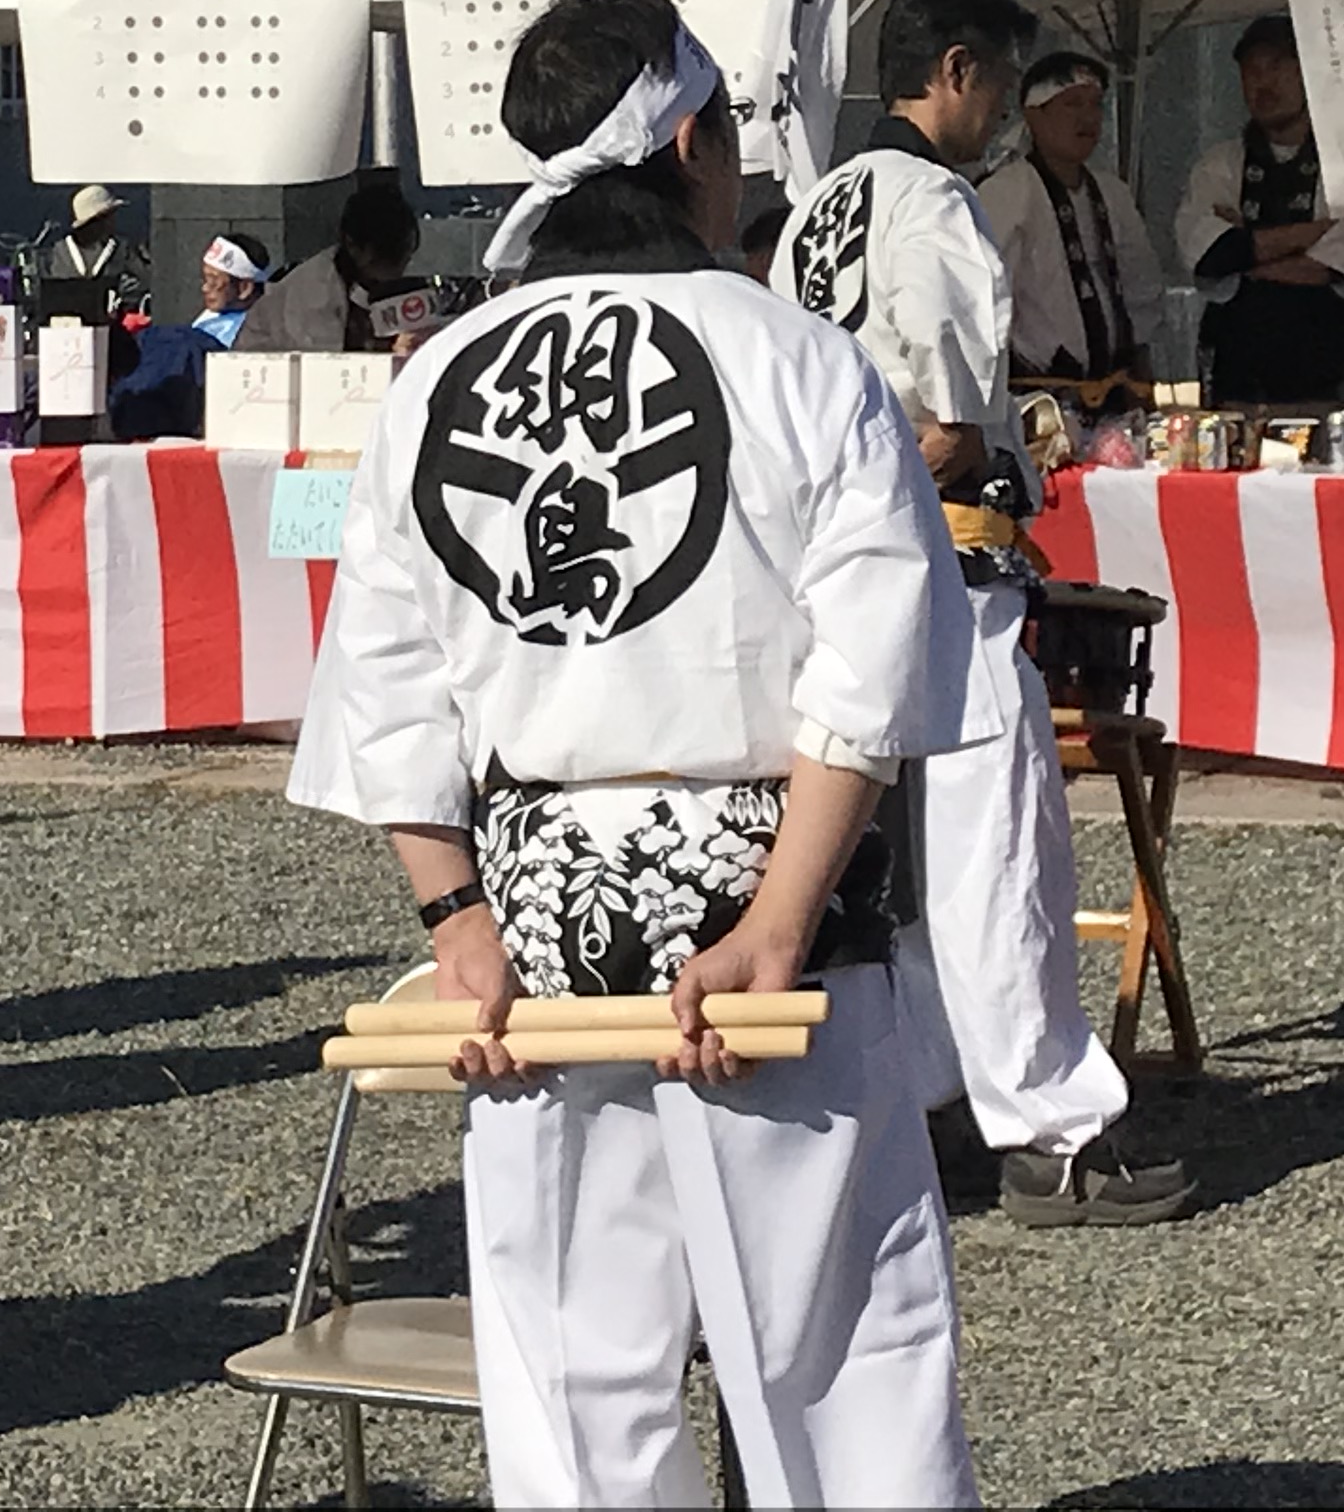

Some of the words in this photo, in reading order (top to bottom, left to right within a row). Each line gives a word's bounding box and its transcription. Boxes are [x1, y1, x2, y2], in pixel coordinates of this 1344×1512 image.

[439, 1, 449, 17] 1
[440, 41, 453, 57] 2
[442, 83, 455, 99] 3
[444, 123, 456, 139] 4
